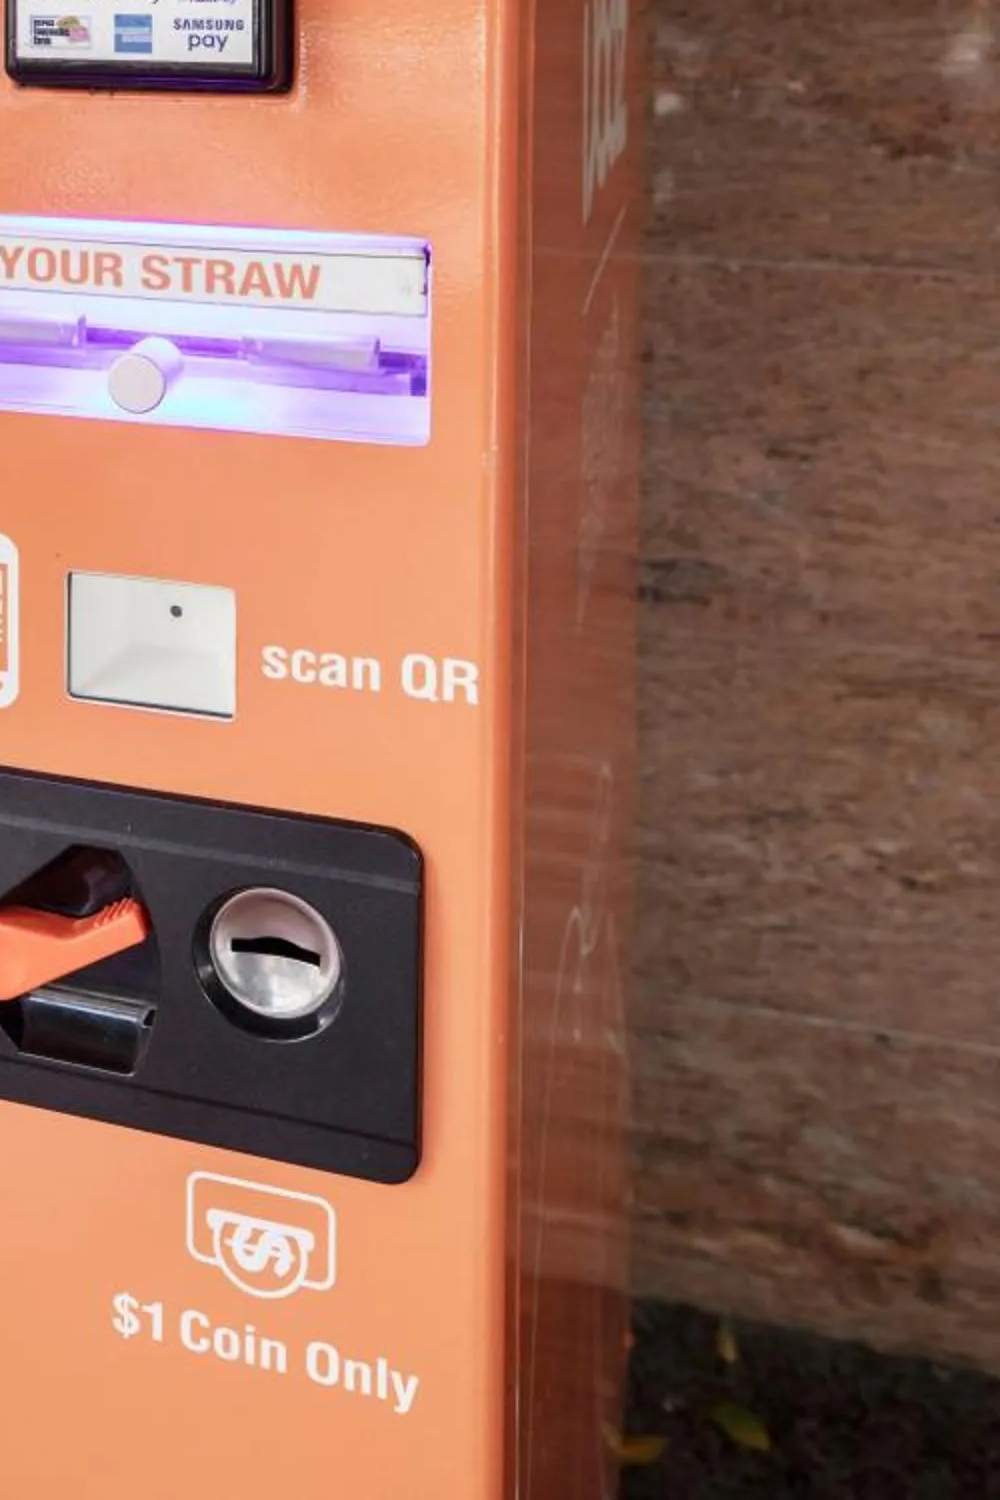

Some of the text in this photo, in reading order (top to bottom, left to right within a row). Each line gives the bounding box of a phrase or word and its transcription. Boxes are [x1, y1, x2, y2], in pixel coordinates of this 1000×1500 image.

[174, 18, 245, 31] SAMSUNG
[188, 35, 229, 52] pay
[142, 254, 322, 300] STRAW
[262, 644, 480, 705] scan QR
[112, 1292, 419, 1414] $1 Coin Only
